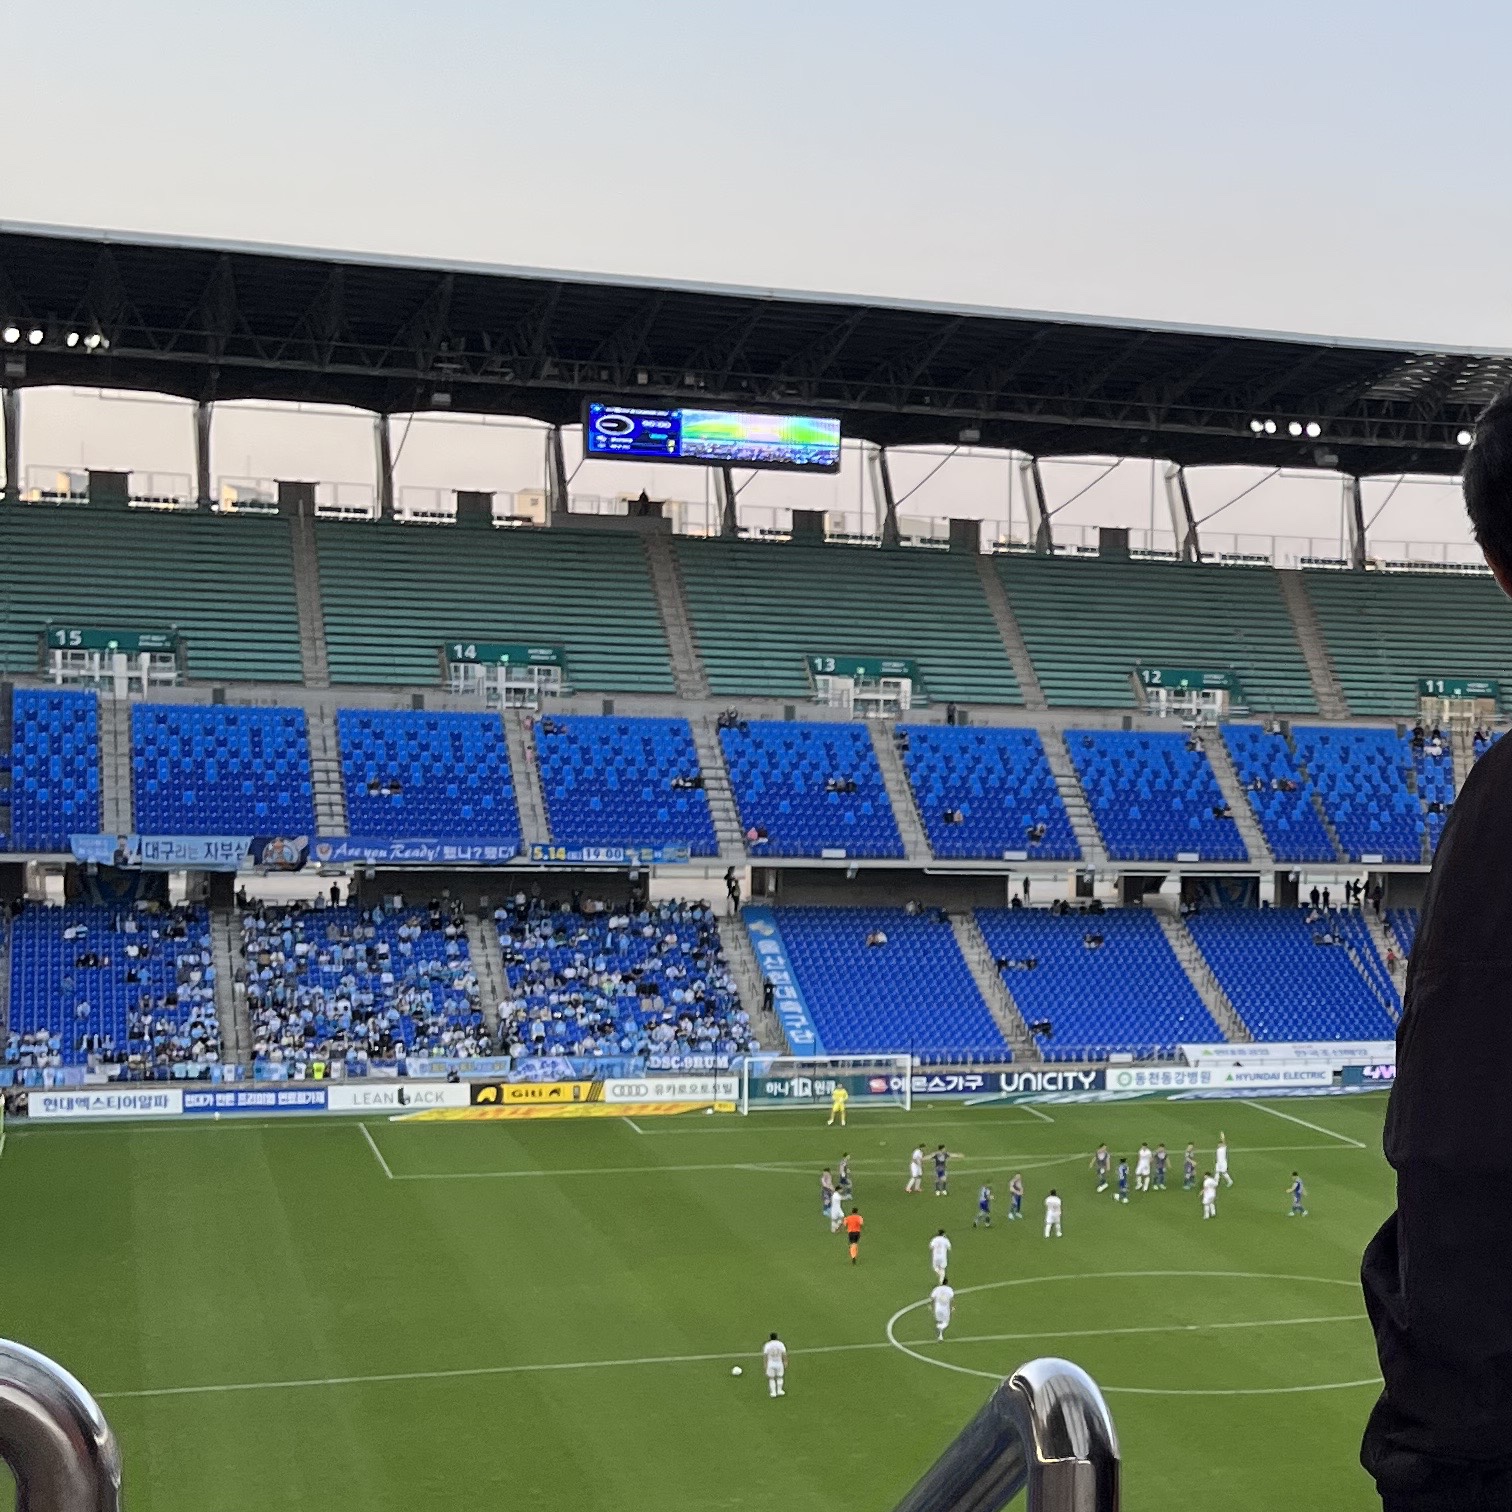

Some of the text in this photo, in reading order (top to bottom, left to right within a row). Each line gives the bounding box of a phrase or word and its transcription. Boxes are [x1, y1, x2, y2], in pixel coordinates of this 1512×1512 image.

[55, 629, 83, 646] 15
[453, 644, 477, 659] 14
[814, 657, 836, 672] 13
[1141, 669, 1162, 684] 12
[1425, 680, 1444, 693] 11
[1000, 1072, 1097, 1092] UNICITY
[1235, 1070, 1326, 1082] HYUNDAI ELECTRIC
